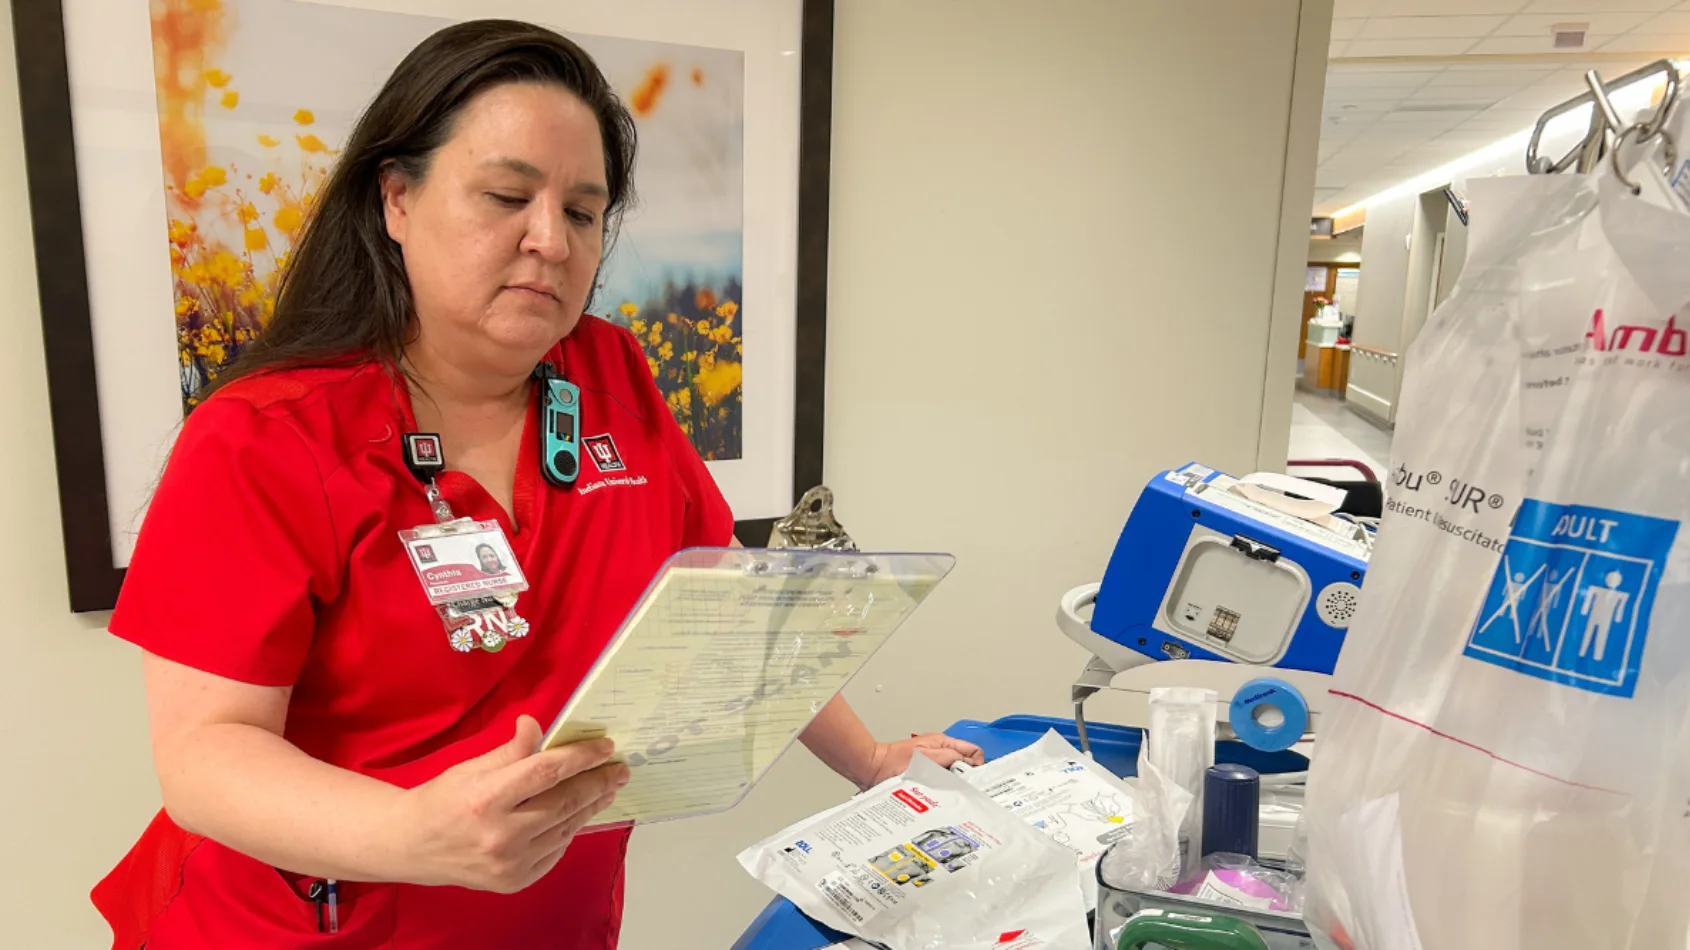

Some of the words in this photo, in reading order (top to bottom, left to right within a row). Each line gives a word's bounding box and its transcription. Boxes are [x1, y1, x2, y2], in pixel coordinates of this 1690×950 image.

[426, 569, 462, 583] Cynthia
[433, 581, 482, 595] REGISTERED
[482, 576, 508, 589] NURSE
[464, 608, 510, 641] RN
